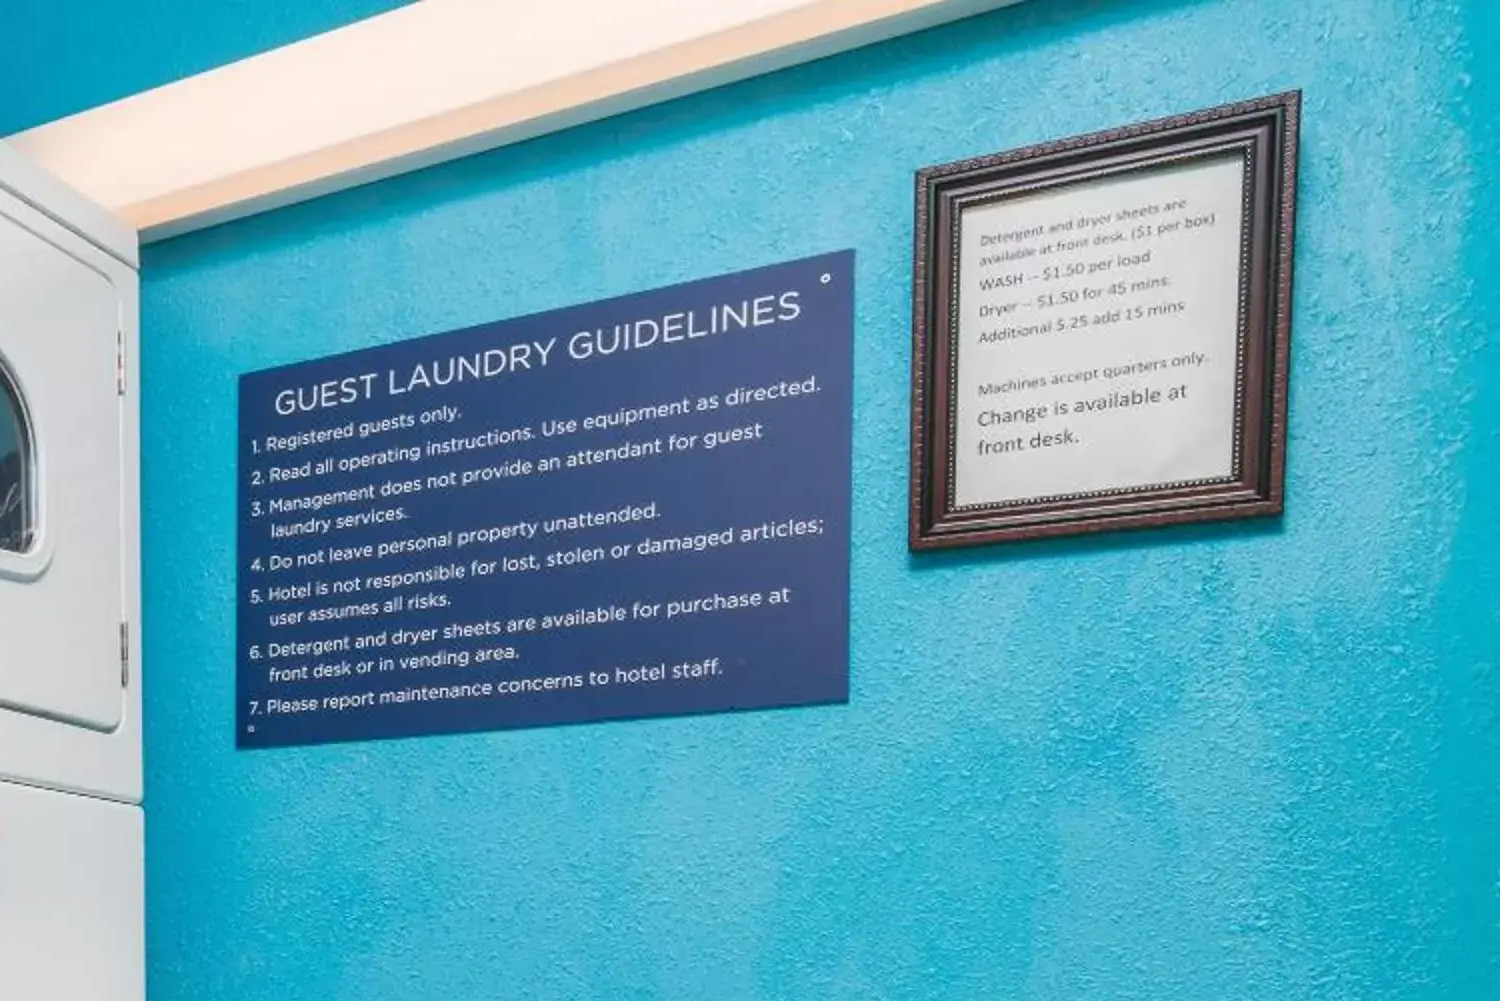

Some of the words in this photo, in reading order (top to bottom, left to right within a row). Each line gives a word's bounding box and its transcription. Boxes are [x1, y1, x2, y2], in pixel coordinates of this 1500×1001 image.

[979, 248, 1036, 267] available
[1056, 238, 1089, 251] front
[275, 373, 377, 415] GUEST
[389, 337, 556, 394] LAUNDRY
[569, 291, 800, 359] GUIDELINES
[978, 378, 1046, 395] Machines
[1051, 369, 1098, 385] accept
[252, 440, 260, 454] 1.
[267, 422, 353, 451] Registered
[359, 415, 415, 437] guests
[420, 405, 461, 424] only.
[252, 471, 264, 485] 2.
[270, 462, 311, 482] Read
[315, 458, 333, 475] all
[338, 447, 421, 472] operating
[426, 427, 535, 456] instructions.
[542, 420, 577, 436] Use
[583, 398, 690, 430] equipment
[696, 395, 719, 411] as
[725, 375, 820, 405] directed.
[977, 407, 1047, 427] Change
[1054, 401, 1068, 415] is
[1074, 388, 1161, 413] available
[252, 501, 265, 517] 3.
[269, 484, 374, 513] Management
[380, 479, 422, 496] does
[427, 472, 456, 488] not
[462, 459, 532, 486] provide
[537, 457, 560, 472] an
[566, 438, 662, 467] attendant
[668, 434, 698, 451] for
[703, 423, 762, 449] guest
[978, 437, 1023, 455] front
[251, 558, 265, 571] 4.
[270, 555, 293, 570] Do
[297, 550, 324, 567] not
[329, 545, 373, 562] leave
[378, 532, 452, 558] personal
[458, 522, 537, 547] property
[544, 502, 660, 533] unattended.
[271, 518, 331, 538] laundry
[336, 507, 409, 528] services.
[250, 589, 263, 604] 5.
[269, 582, 311, 600] Hotel
[316, 582, 328, 595] is
[333, 577, 361, 593] not
[366, 564, 465, 589] responsible
[471, 560, 497, 576] for
[503, 555, 540, 572] lost,
[547, 547, 604, 567] stolen
[610, 545, 631, 559] or
[637, 527, 733, 555] damaged
[740, 519, 823, 542] articles;
[249, 645, 263, 659] 6.
[269, 637, 350, 658] Detergent
[355, 631, 387, 649] and
[391, 629, 438, 645] dryer
[443, 621, 501, 639] sheets
[507, 618, 536, 632] are
[541, 606, 626, 629] available
[633, 602, 660, 619] for
[667, 593, 762, 618] purchase
[769, 588, 790, 604] at
[270, 612, 304, 626] user
[308, 603, 379, 622] assumes
[383, 596, 402, 613] all
[408, 592, 451, 609] risks.
[249, 701, 262, 715] 7.
[267, 699, 318, 713] Please
[323, 692, 374, 710] report
[380, 683, 493, 704] maintenance
[497, 675, 583, 693] concerns
[589, 672, 609, 685] to
[615, 663, 665, 682] hotel
[673, 657, 722, 678] staff.
[269, 666, 308, 682] front
[313, 661, 351, 678] desk
[356, 661, 374, 673] or
[379, 657, 394, 671] in
[399, 651, 469, 669] vending
[475, 647, 519, 662] area.
